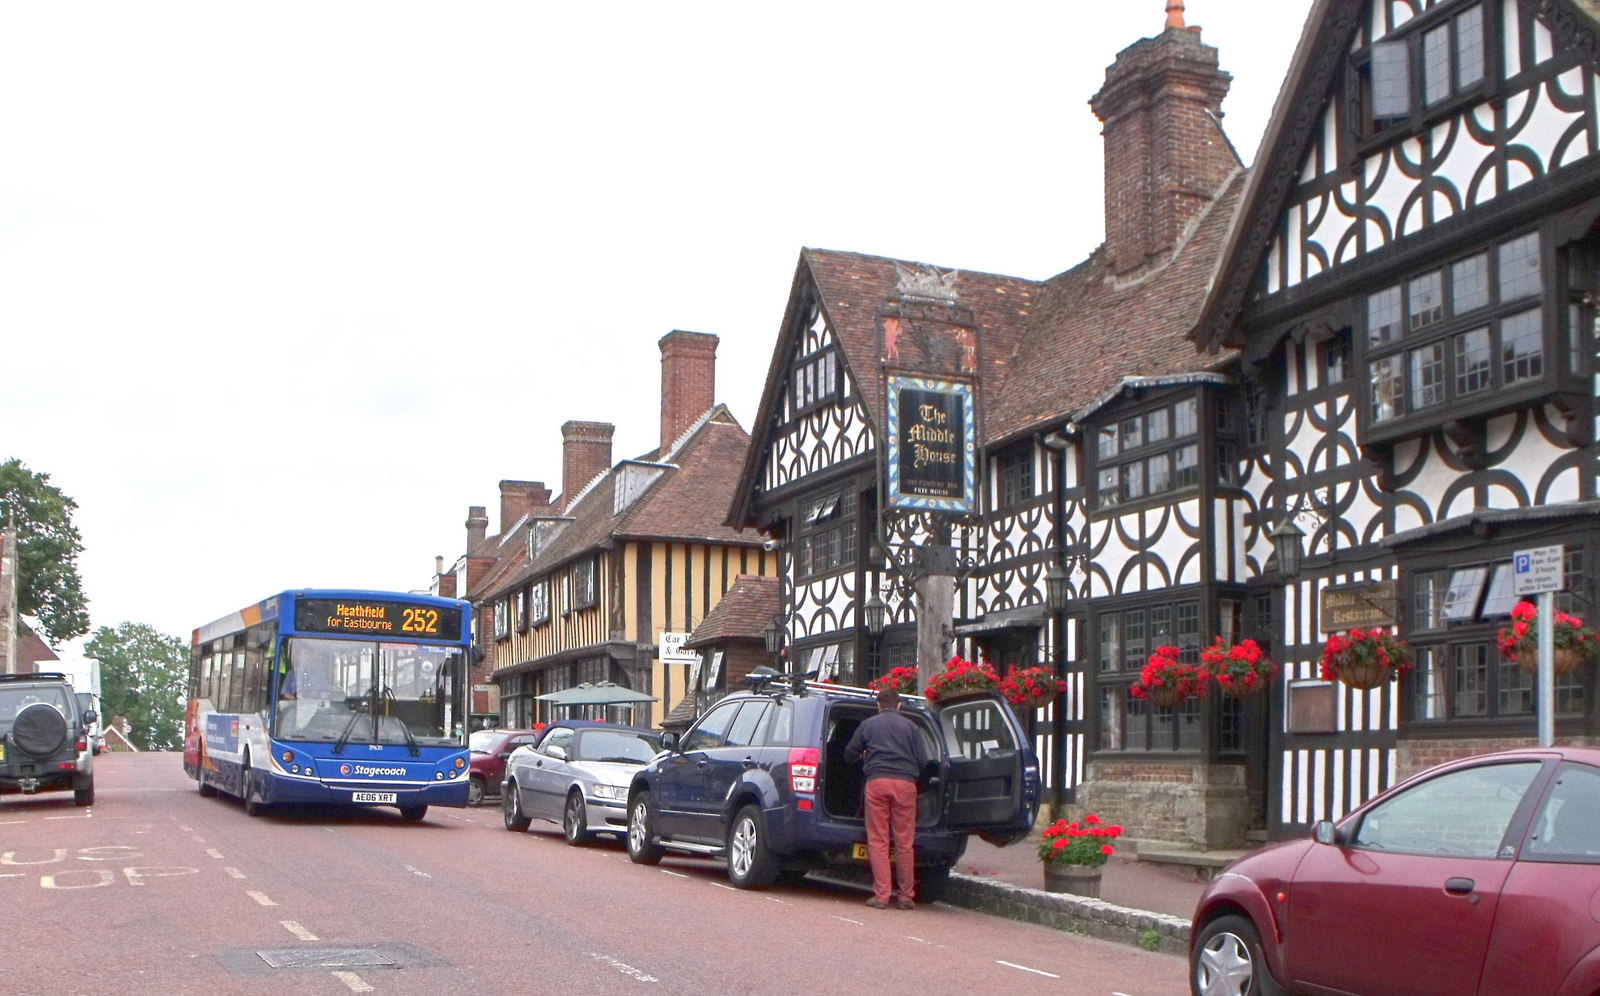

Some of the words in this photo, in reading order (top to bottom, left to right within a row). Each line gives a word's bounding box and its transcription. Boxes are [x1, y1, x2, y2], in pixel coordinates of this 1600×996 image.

[918, 404, 947, 425] The
[907, 423, 955, 444] Middle
[913, 443, 956, 469] House
[929, 488, 949, 496] HOUSE
[1519, 557, 1528, 572] P
[337, 604, 385, 619] Heathfield
[1333, 605, 1384, 624] Restaurant
[327, 616, 342, 627] for
[343, 617, 393, 630] Eastbourne
[402, 608, 439, 633] 252
[665, 635, 681, 643] Car
[665, 646, 672, 655] &
[354, 765, 407, 777] Stagecoach
[355, 793, 377, 802] AE06
[378, 793, 394, 802] XRT
[0, 846, 144, 865] US
[0, 866, 199, 890] OP
